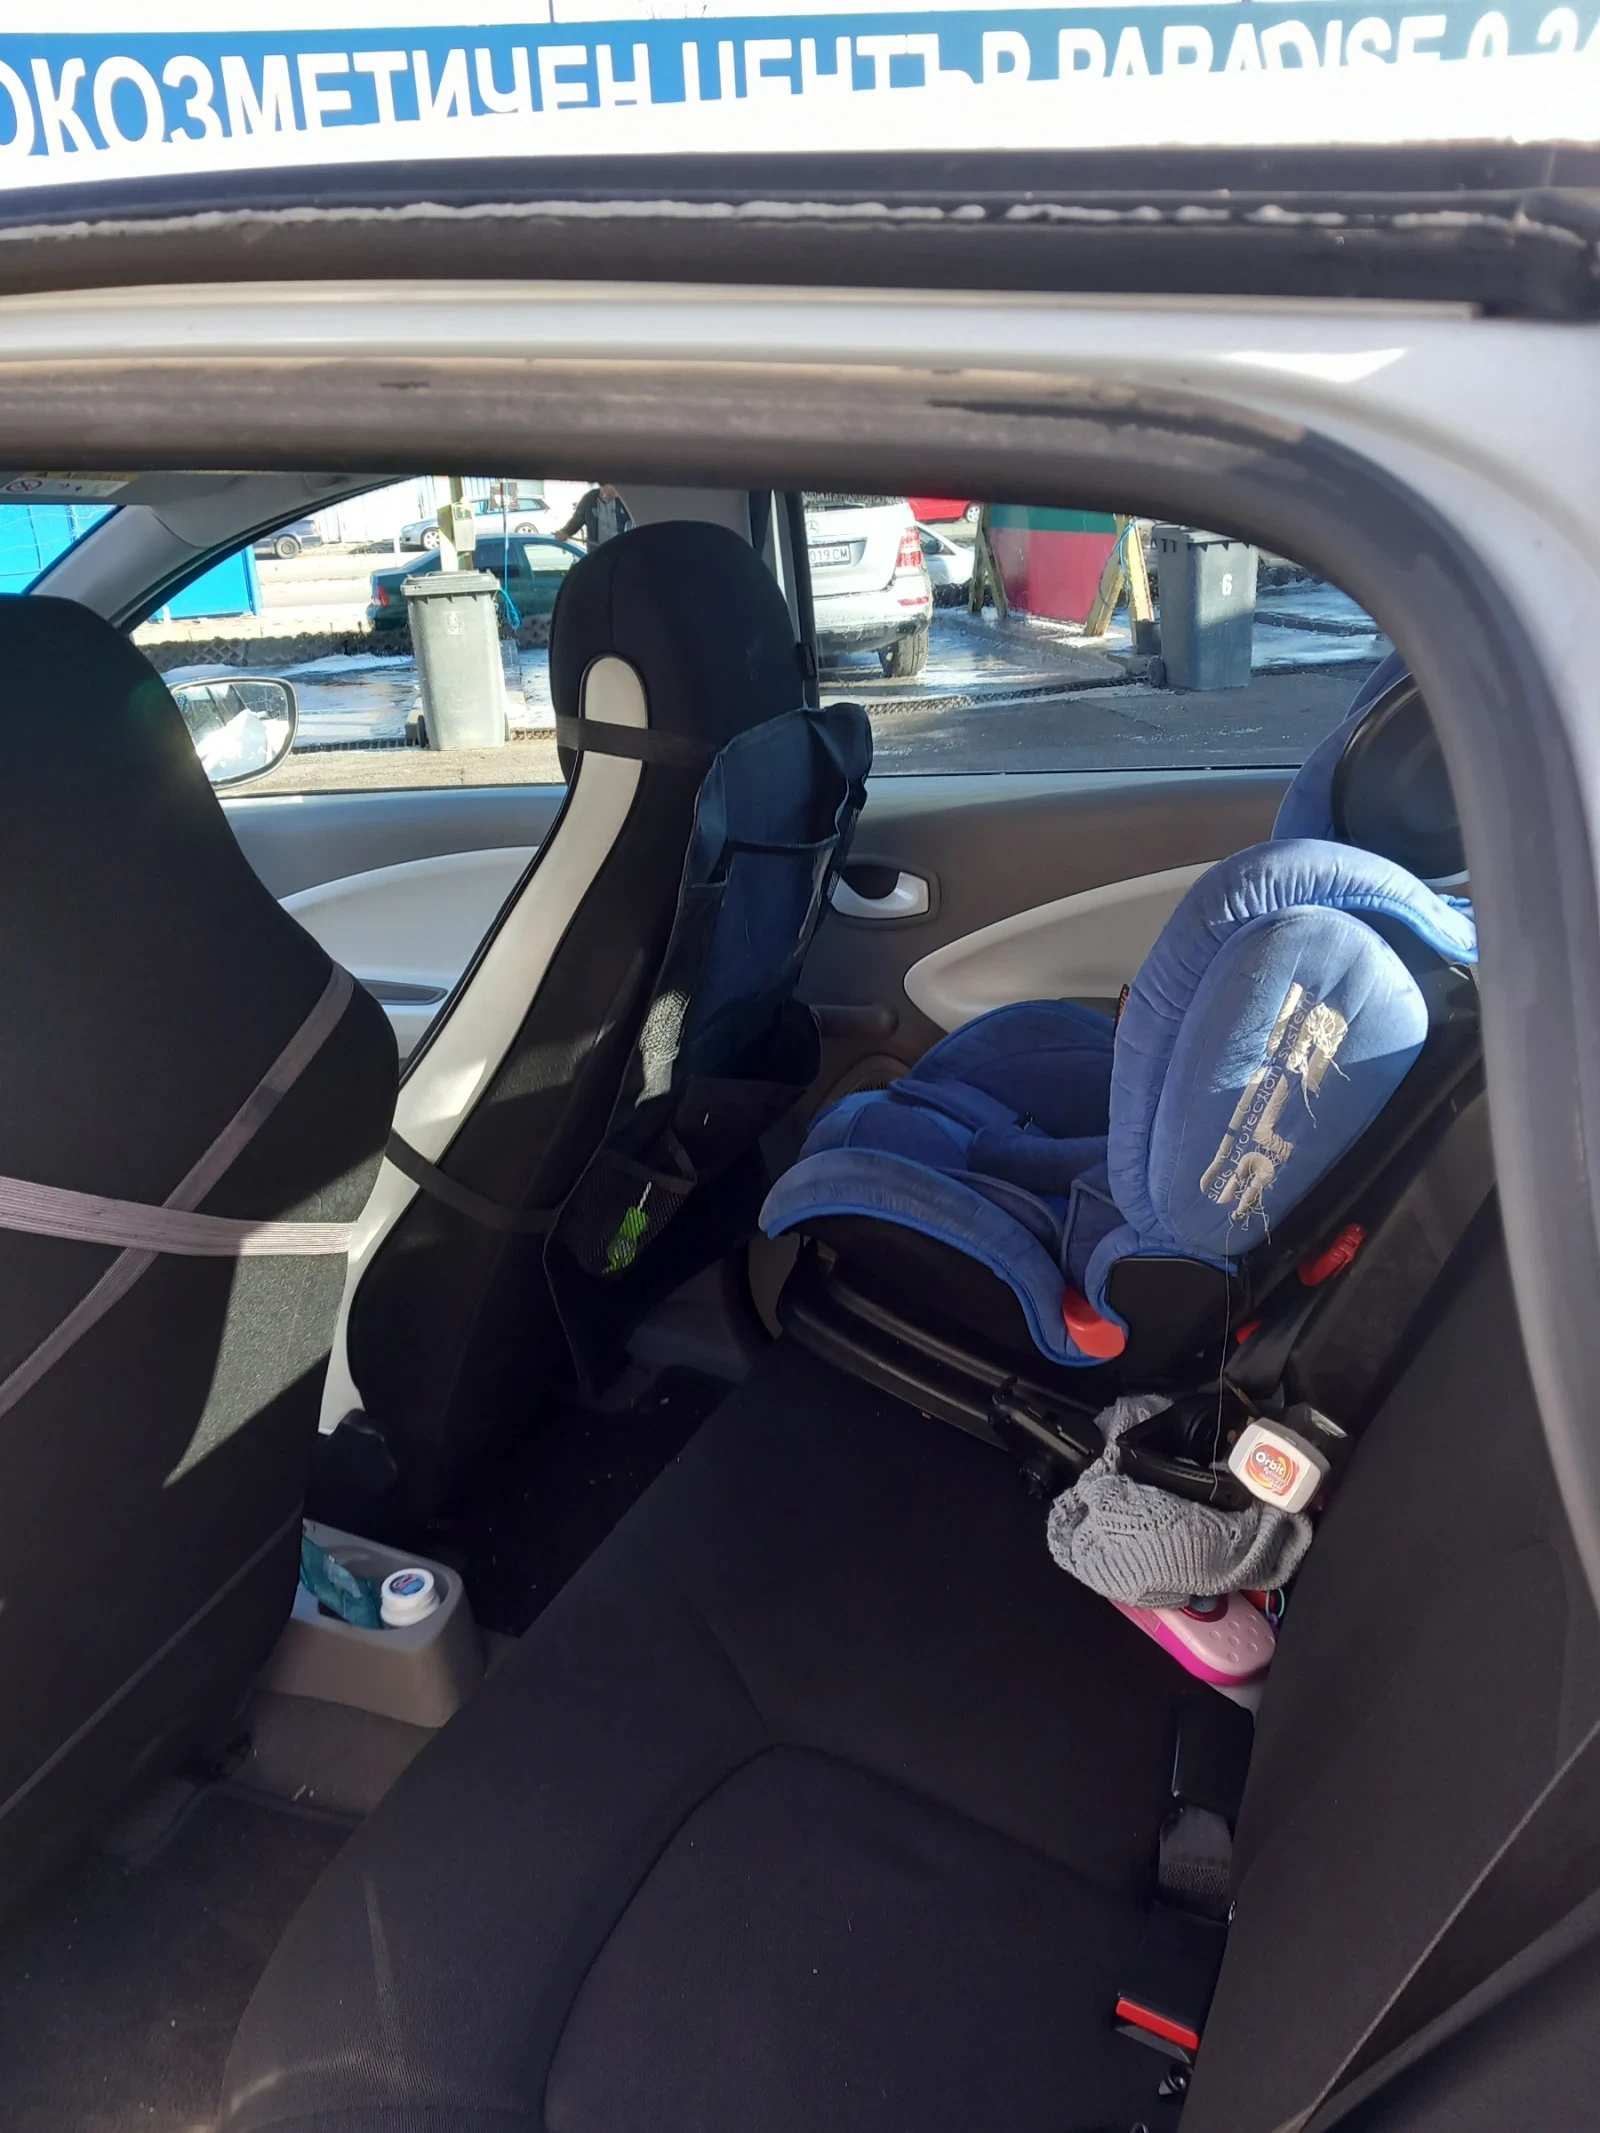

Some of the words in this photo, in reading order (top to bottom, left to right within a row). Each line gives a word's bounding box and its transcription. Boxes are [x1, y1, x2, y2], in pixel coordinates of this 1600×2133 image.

[1221, 573, 1233, 595] 6
[1230, 1065, 1283, 1166] protection
[1277, 991, 1316, 1060] system
[1255, 1451, 1285, 1476] Orbit
